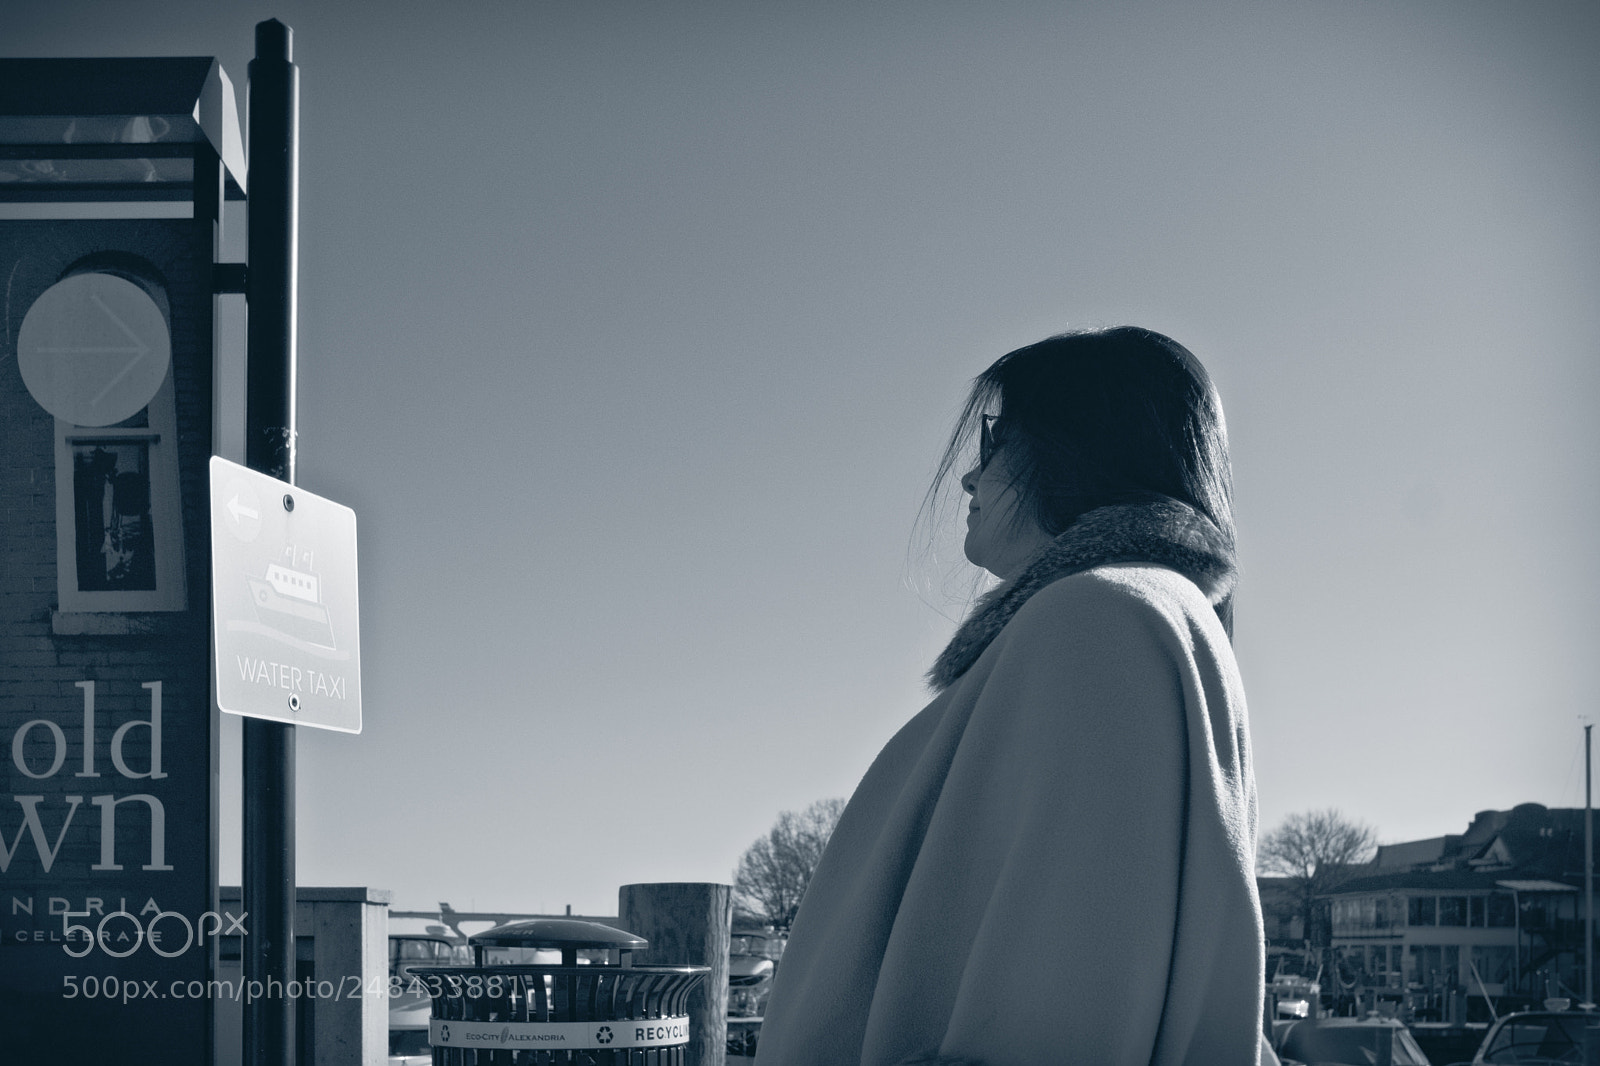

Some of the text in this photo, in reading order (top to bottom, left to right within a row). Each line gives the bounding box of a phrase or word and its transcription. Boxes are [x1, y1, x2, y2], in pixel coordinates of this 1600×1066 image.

[236, 654, 346, 700] WATER TAXI
[11, 680, 168, 780] old
[15, 930, 163, 942] CELEBRATE
